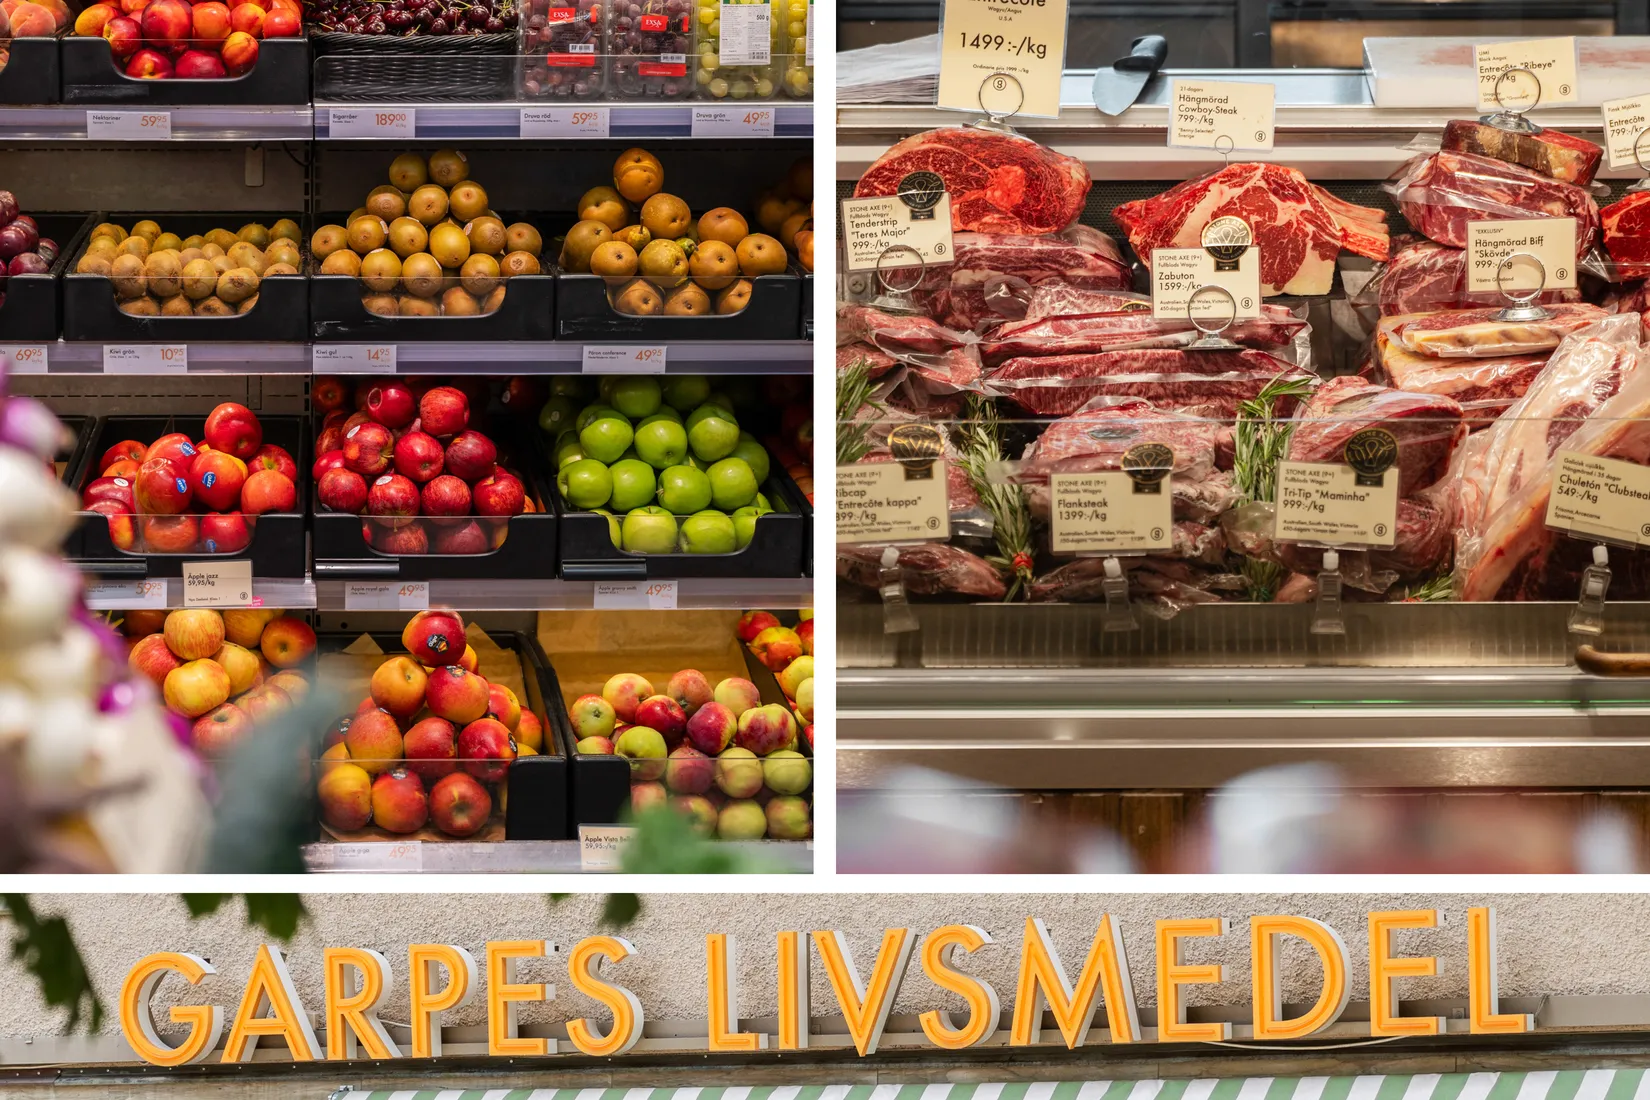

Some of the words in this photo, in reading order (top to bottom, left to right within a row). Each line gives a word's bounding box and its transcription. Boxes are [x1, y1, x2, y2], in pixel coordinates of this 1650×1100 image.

[1179, 94, 1229, 104] Hängmörad
[1178, 104, 1238, 115] Cowboy-Steak
[1178, 114, 1214, 126] 799:-/kg
[1609, 116, 1645, 128] Entrecôte
[850, 218, 898, 229] Tenderstrip
[851, 230, 878, 239] "Teres
[881, 227, 911, 239] Major"
[1475, 237, 1527, 249] Hängmörad
[1530, 236, 1544, 247] Biff
[1158, 272, 1194, 281] Zabuton
[1559, 474, 1601, 490] Chuletón
[1284, 488, 1312, 500] Tri-Tip
[1315, 490, 1370, 503] "Maminha"
[1557, 485, 1598, 504] 549:-/kg
[886, 496, 921, 509] kappa"
[1057, 498, 1108, 509] Flanksteak
[1283, 500, 1325, 513] 999:-/kg
[1059, 510, 1107, 522] 1399:-/kg
[188, 572, 205, 580] Äpple
[188, 579, 215, 587] 59,95/kg
[585, 834, 602, 843] Äpple
[120, 935, 645, 1066] GARPES
[707, 906, 1535, 1058] LIVSMEDEL
